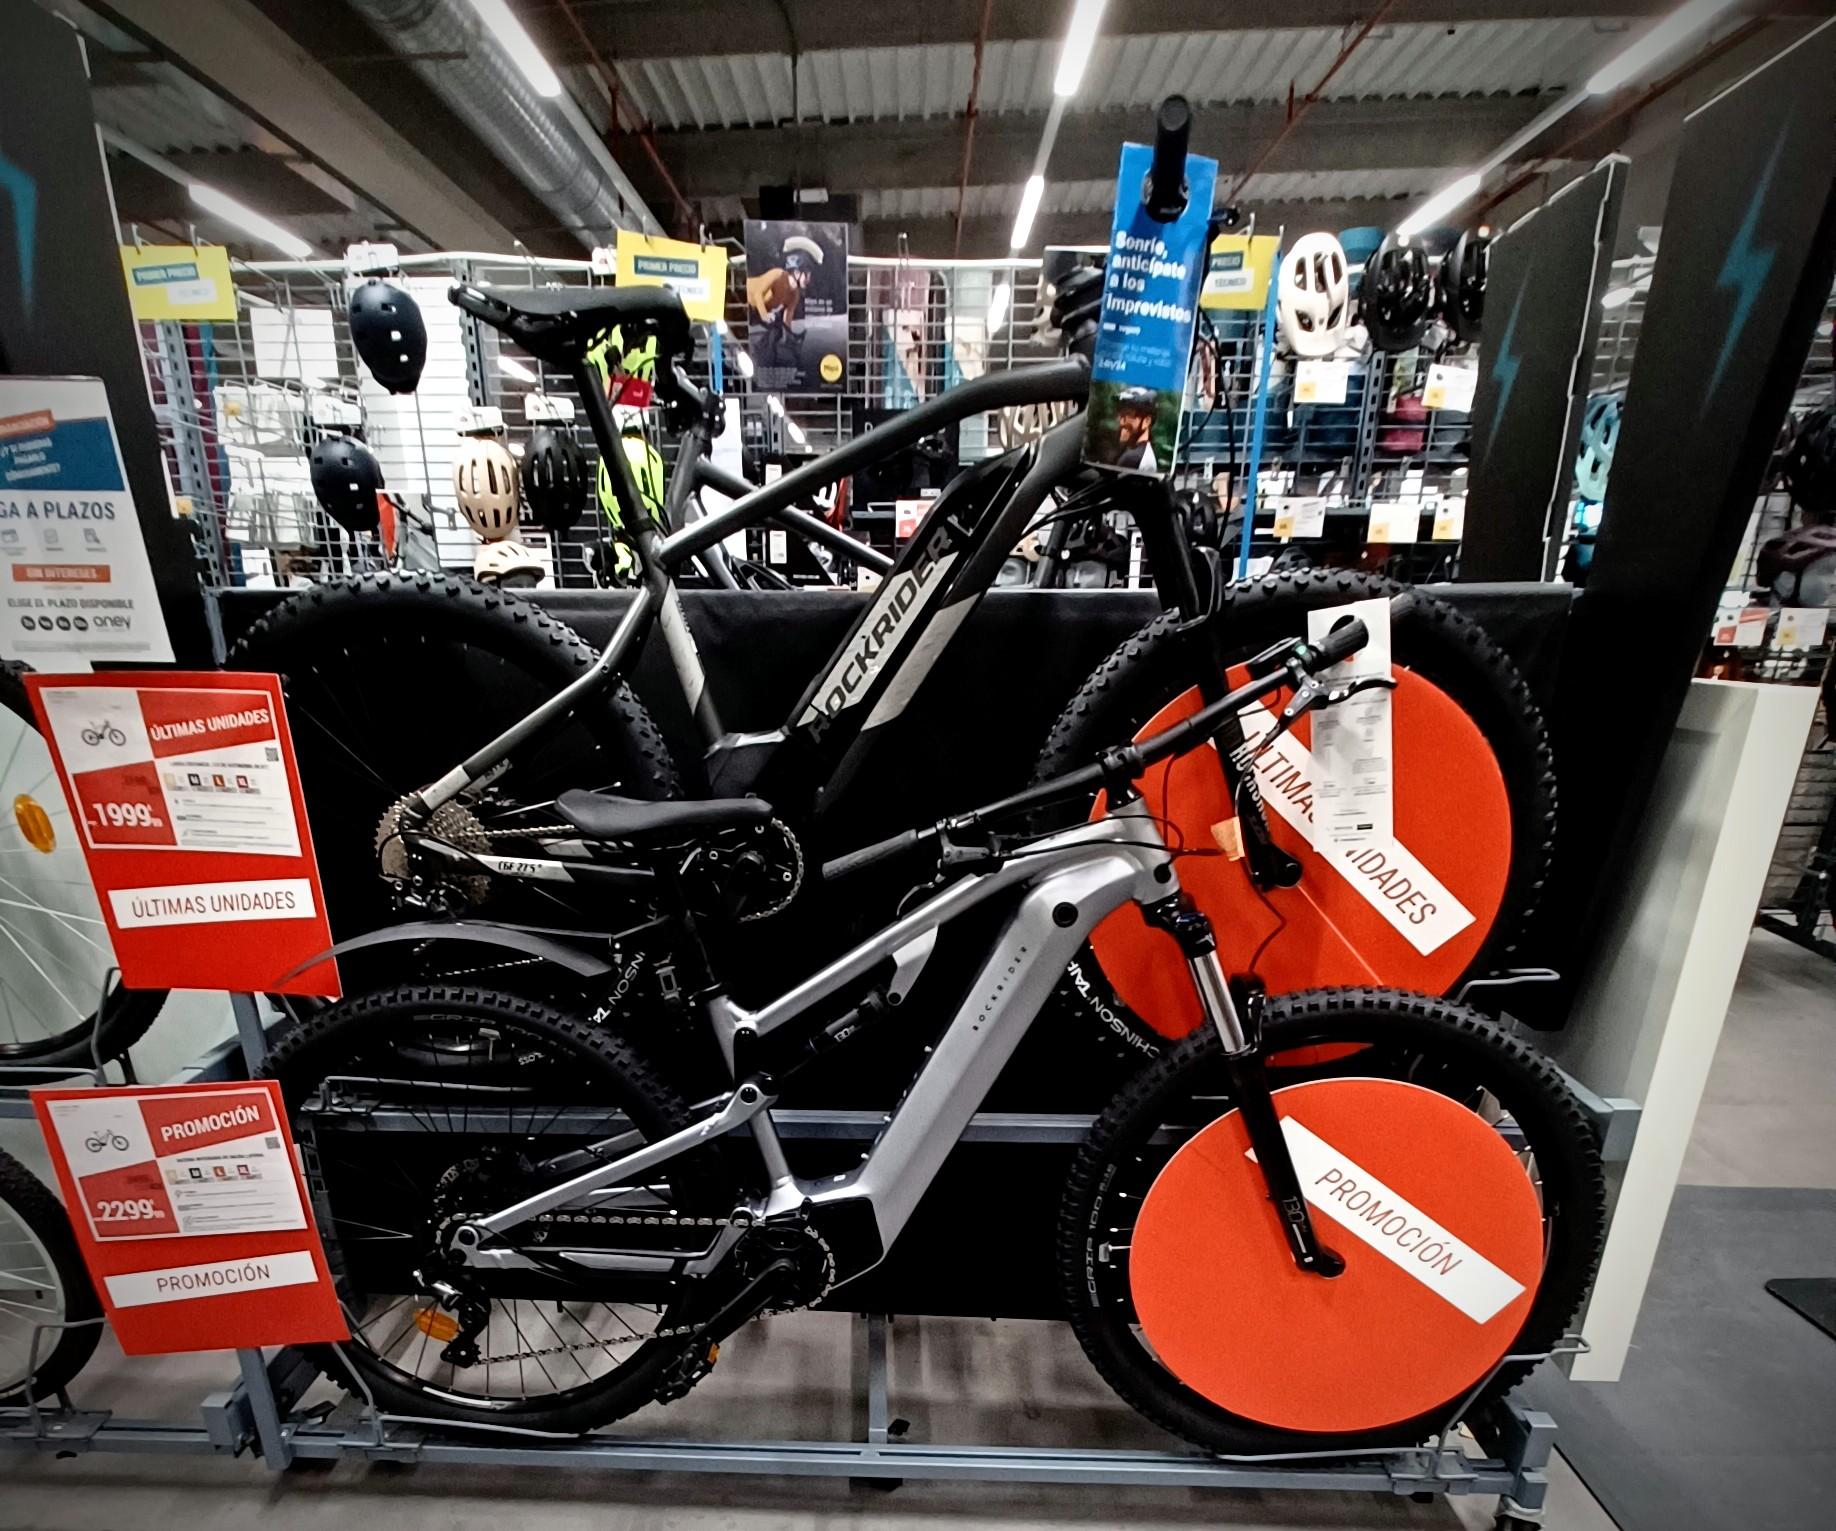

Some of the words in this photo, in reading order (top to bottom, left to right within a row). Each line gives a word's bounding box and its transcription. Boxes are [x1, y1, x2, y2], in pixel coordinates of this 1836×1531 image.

[1109, 273, 1119, 288] a
[1122, 272, 1146, 292] los
[27, 501, 38, 518] A
[43, 501, 116, 520] PLAZOS
[80, 598, 135, 610] DISPONIBLE
[807, 525, 953, 744] ROCKRIDER
[151, 717, 206, 741] ÚLTIMAS
[207, 708, 270, 732] UNIDADES
[132, 894, 207, 918] ÚLTIMAS
[211, 890, 296, 913] UNIDADES
[972, 945, 1028, 1032] ROCKRIDER
[160, 1105, 260, 1142] PROMOCIÓN
[1314, 1168, 1463, 1277] PROMOCIÓN
[156, 1262, 271, 1293] PROMOCIÓN
